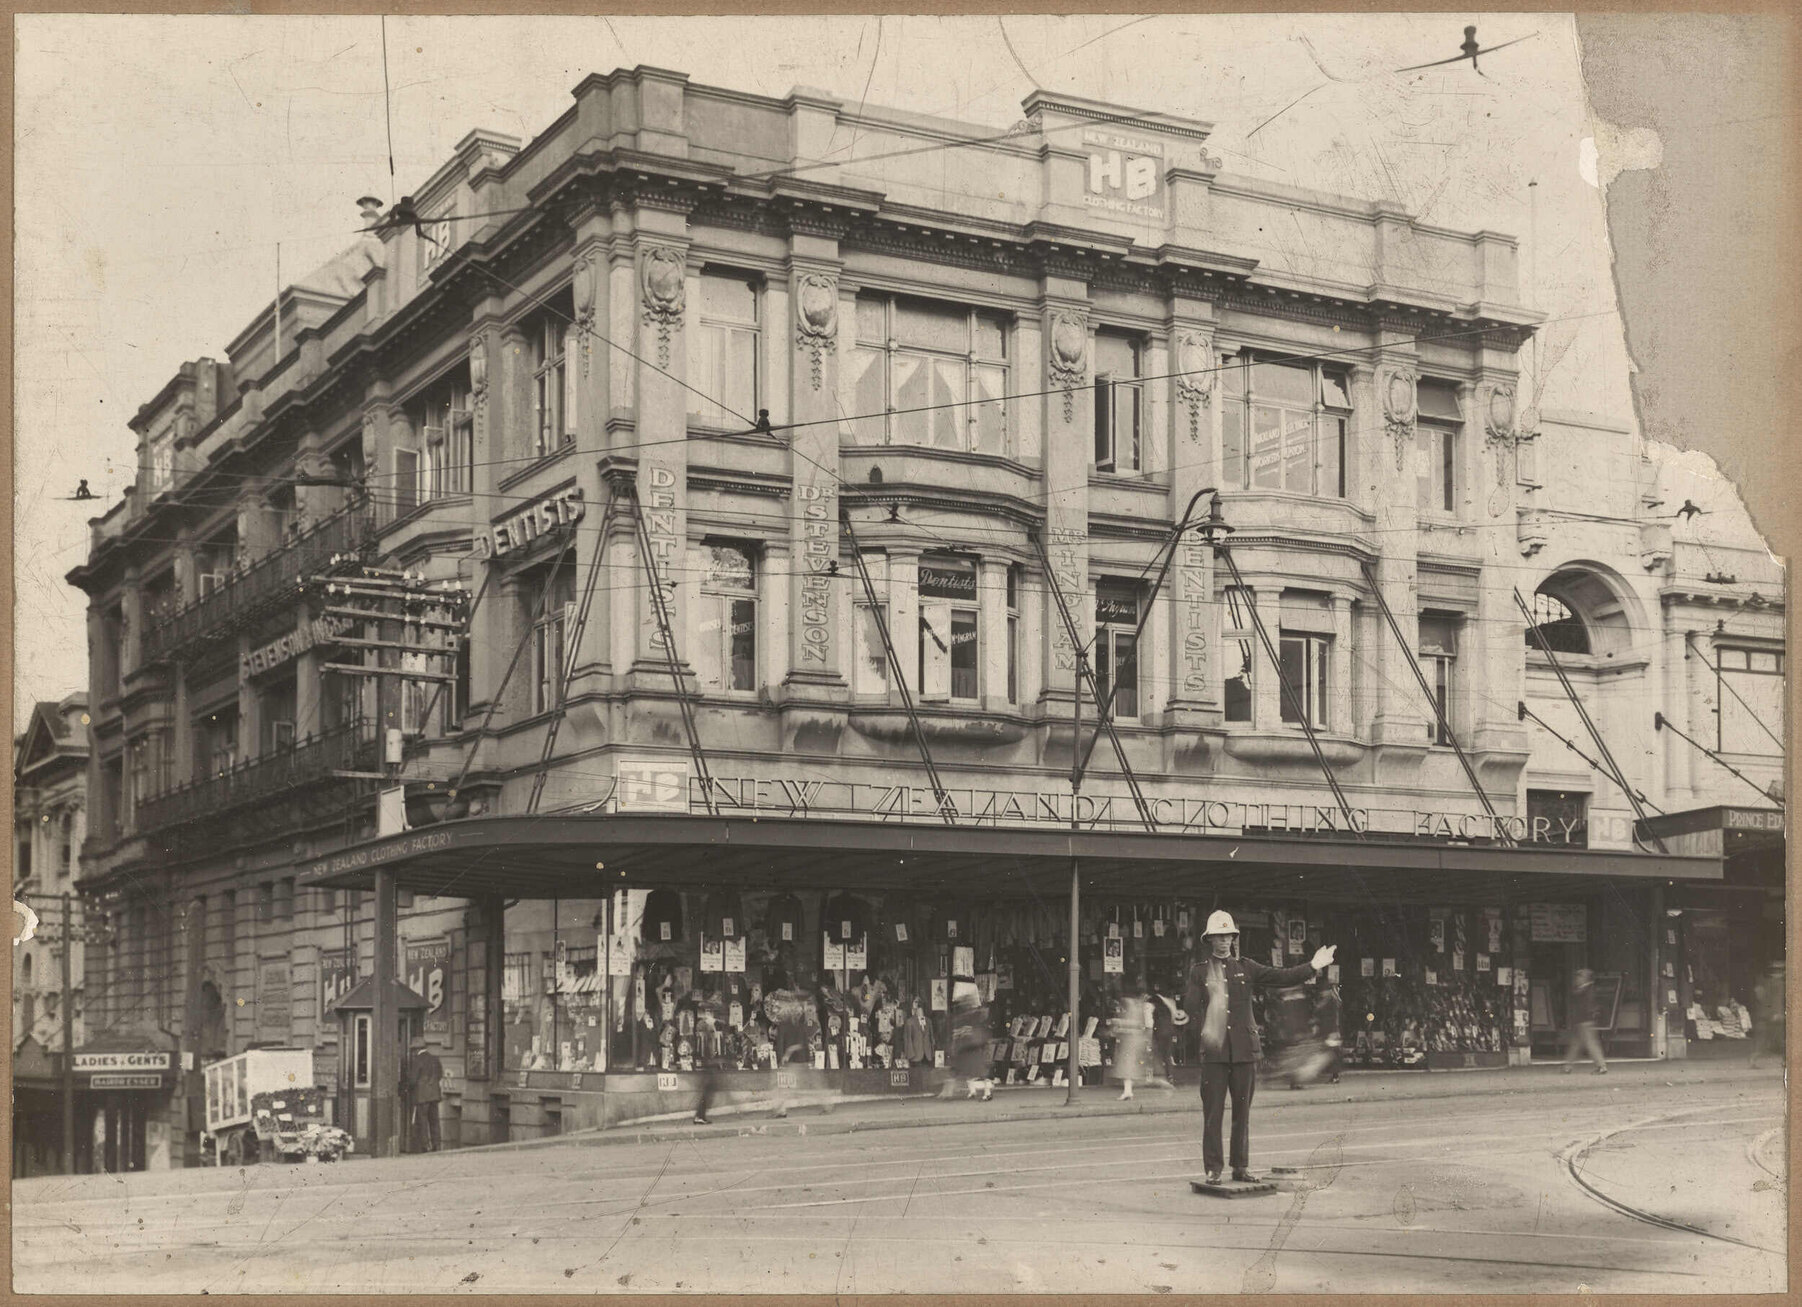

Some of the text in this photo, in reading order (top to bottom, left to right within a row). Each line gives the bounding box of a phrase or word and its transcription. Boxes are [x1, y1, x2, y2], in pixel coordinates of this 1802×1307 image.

[1090, 150, 1157, 200] HB
[480, 487, 583, 559] DENTISTS
[802, 504, 830, 663] STEVENSON
[1053, 549, 1083, 671] INGRAM
[1183, 532, 1208, 692] DENTISTS
[627, 769, 680, 802] HB
[711, 777, 1578, 844] NEW ZEALAND CLOTHING FACTORY
[1593, 816, 1627, 841] HB
[1729, 809, 1764, 829] PRINCE
[313, 832, 453, 876] NEW ZEALAND CLOTHING FACTORY
[74, 1056, 118, 1067] LADIES
